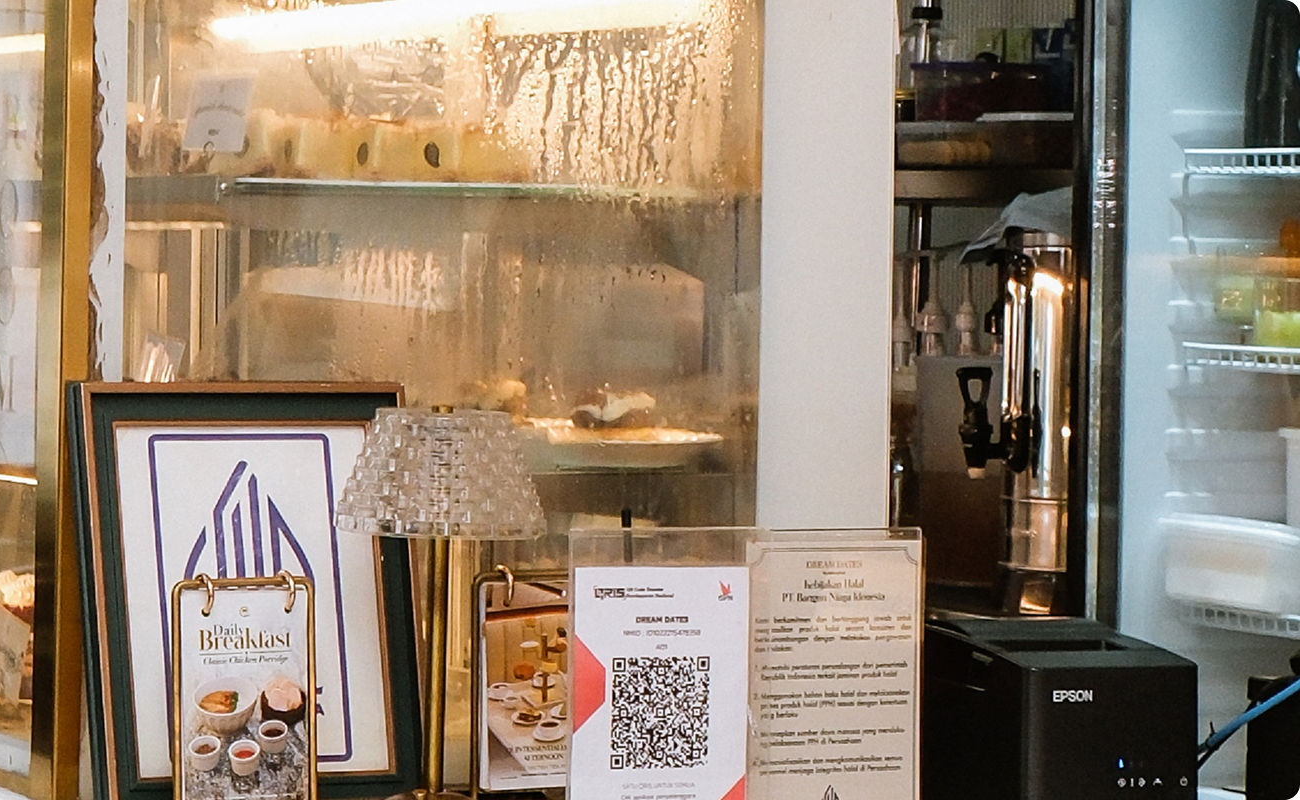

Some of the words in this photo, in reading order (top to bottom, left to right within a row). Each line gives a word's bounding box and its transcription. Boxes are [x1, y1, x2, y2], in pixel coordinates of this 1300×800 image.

[635, 616, 662, 624] DREAM
[664, 616, 689, 624] DATES
[213, 623, 243, 637] Daily
[199, 627, 291, 650] Breakfast
[1053, 690, 1093, 702] EPSON
